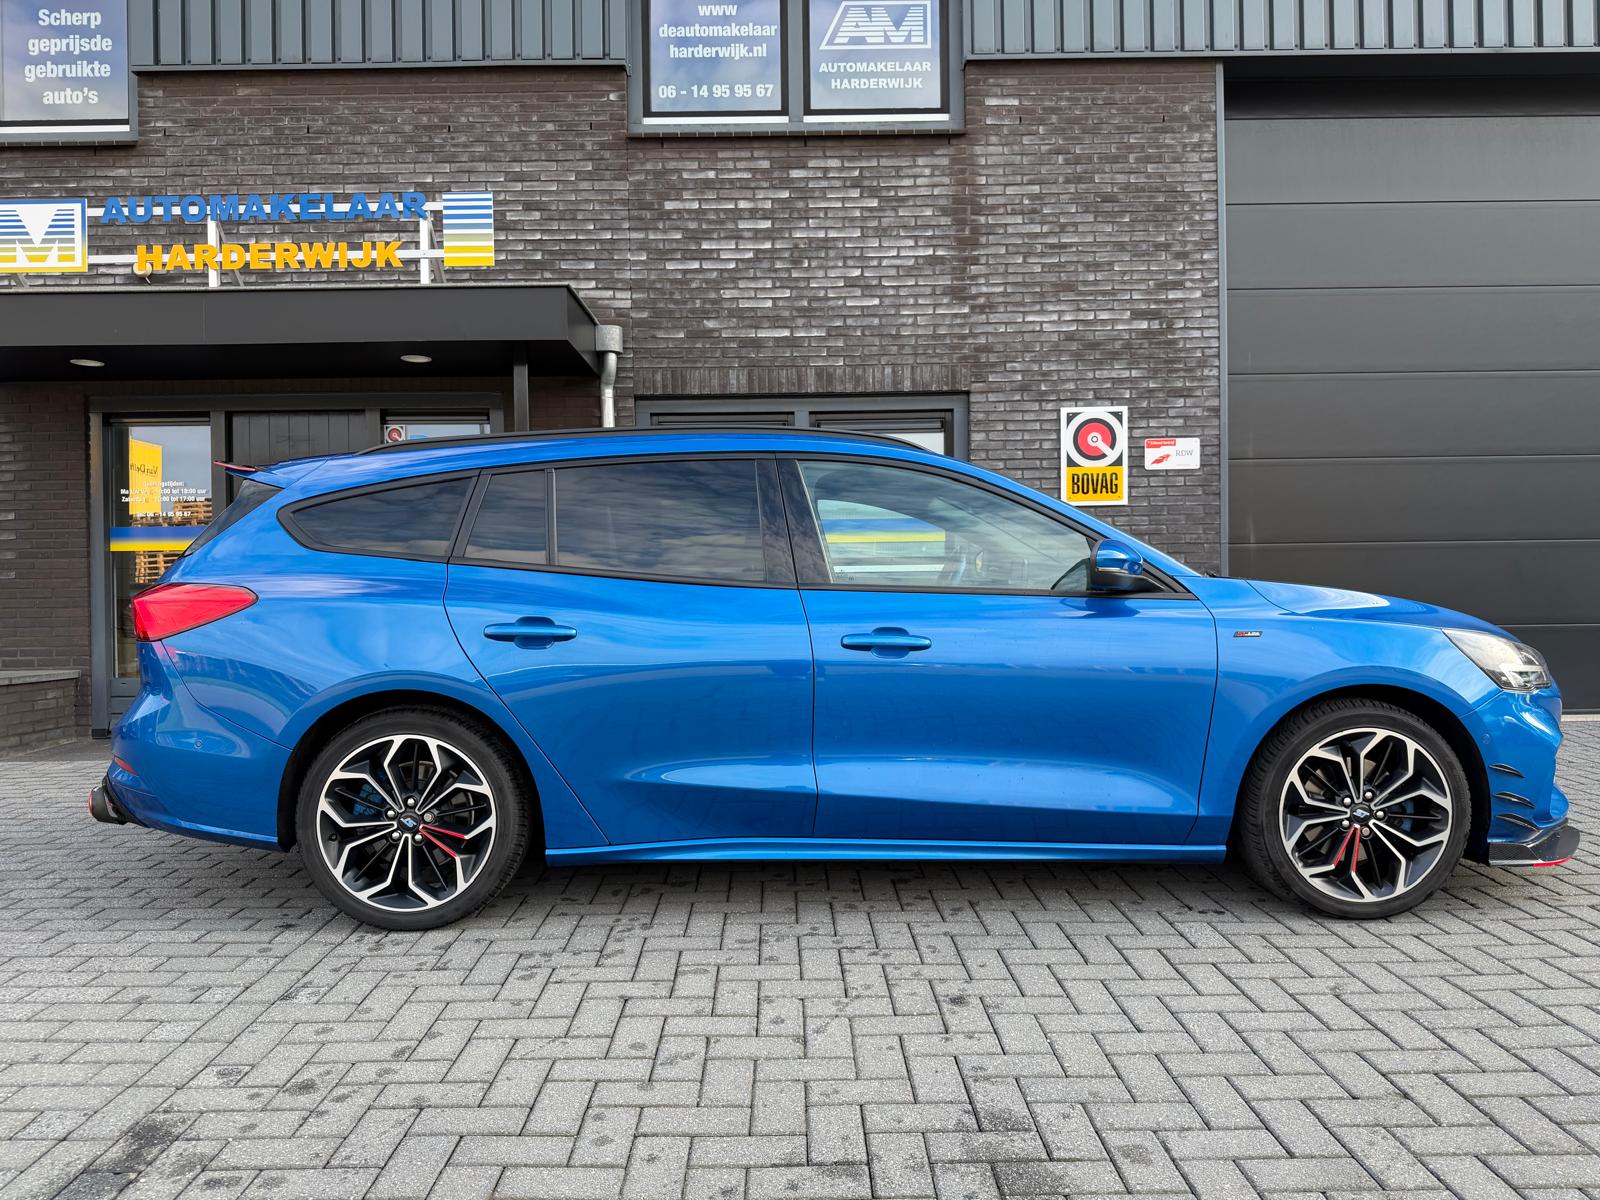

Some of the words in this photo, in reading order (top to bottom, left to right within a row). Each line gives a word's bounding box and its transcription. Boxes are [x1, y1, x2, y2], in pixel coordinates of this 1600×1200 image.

[38, 8, 102, 28] Scherp
[698, 4, 738, 16] www
[659, 22, 778, 37] deautomakelaar
[28, 34, 113, 55] geprijsde
[669, 43, 767, 60] harderwijk.nl
[24, 60, 111, 82] gebruikte
[819, 61, 932, 73] AUTOMAKELAAR
[658, 85, 677, 98] 06
[691, 84, 709, 98] 14
[712, 84, 730, 98] 95
[734, 84, 752, 98] 95
[756, 83, 774, 97] 67
[831, 77, 923, 89] HARDERWIJK
[42, 87, 99, 104] auto's
[99, 191, 428, 224] AUTOMAKELAAR
[136, 241, 403, 271] HARDERWIJK
[1175, 449, 1194, 457] RDW
[1071, 472, 1119, 495] BOVAG
